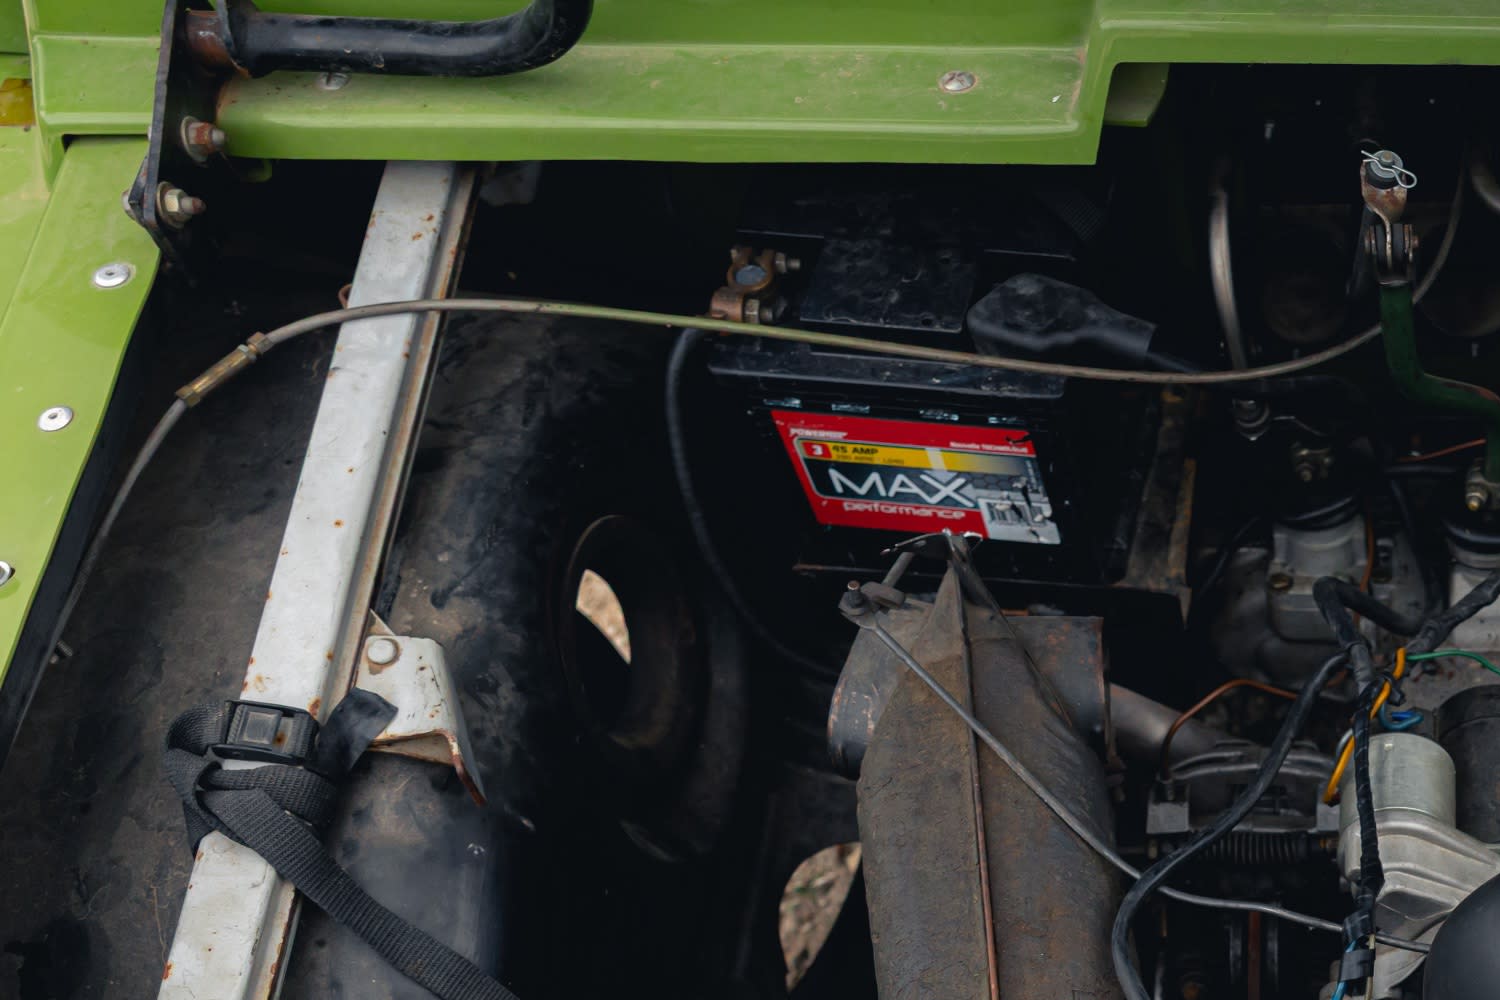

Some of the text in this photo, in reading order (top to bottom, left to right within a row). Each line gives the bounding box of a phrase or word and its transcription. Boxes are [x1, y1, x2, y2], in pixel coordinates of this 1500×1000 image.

[811, 444, 824, 456] 3
[852, 446, 878, 456] AMP
[828, 468, 976, 508] MAX
[843, 501, 966, 520] performance
